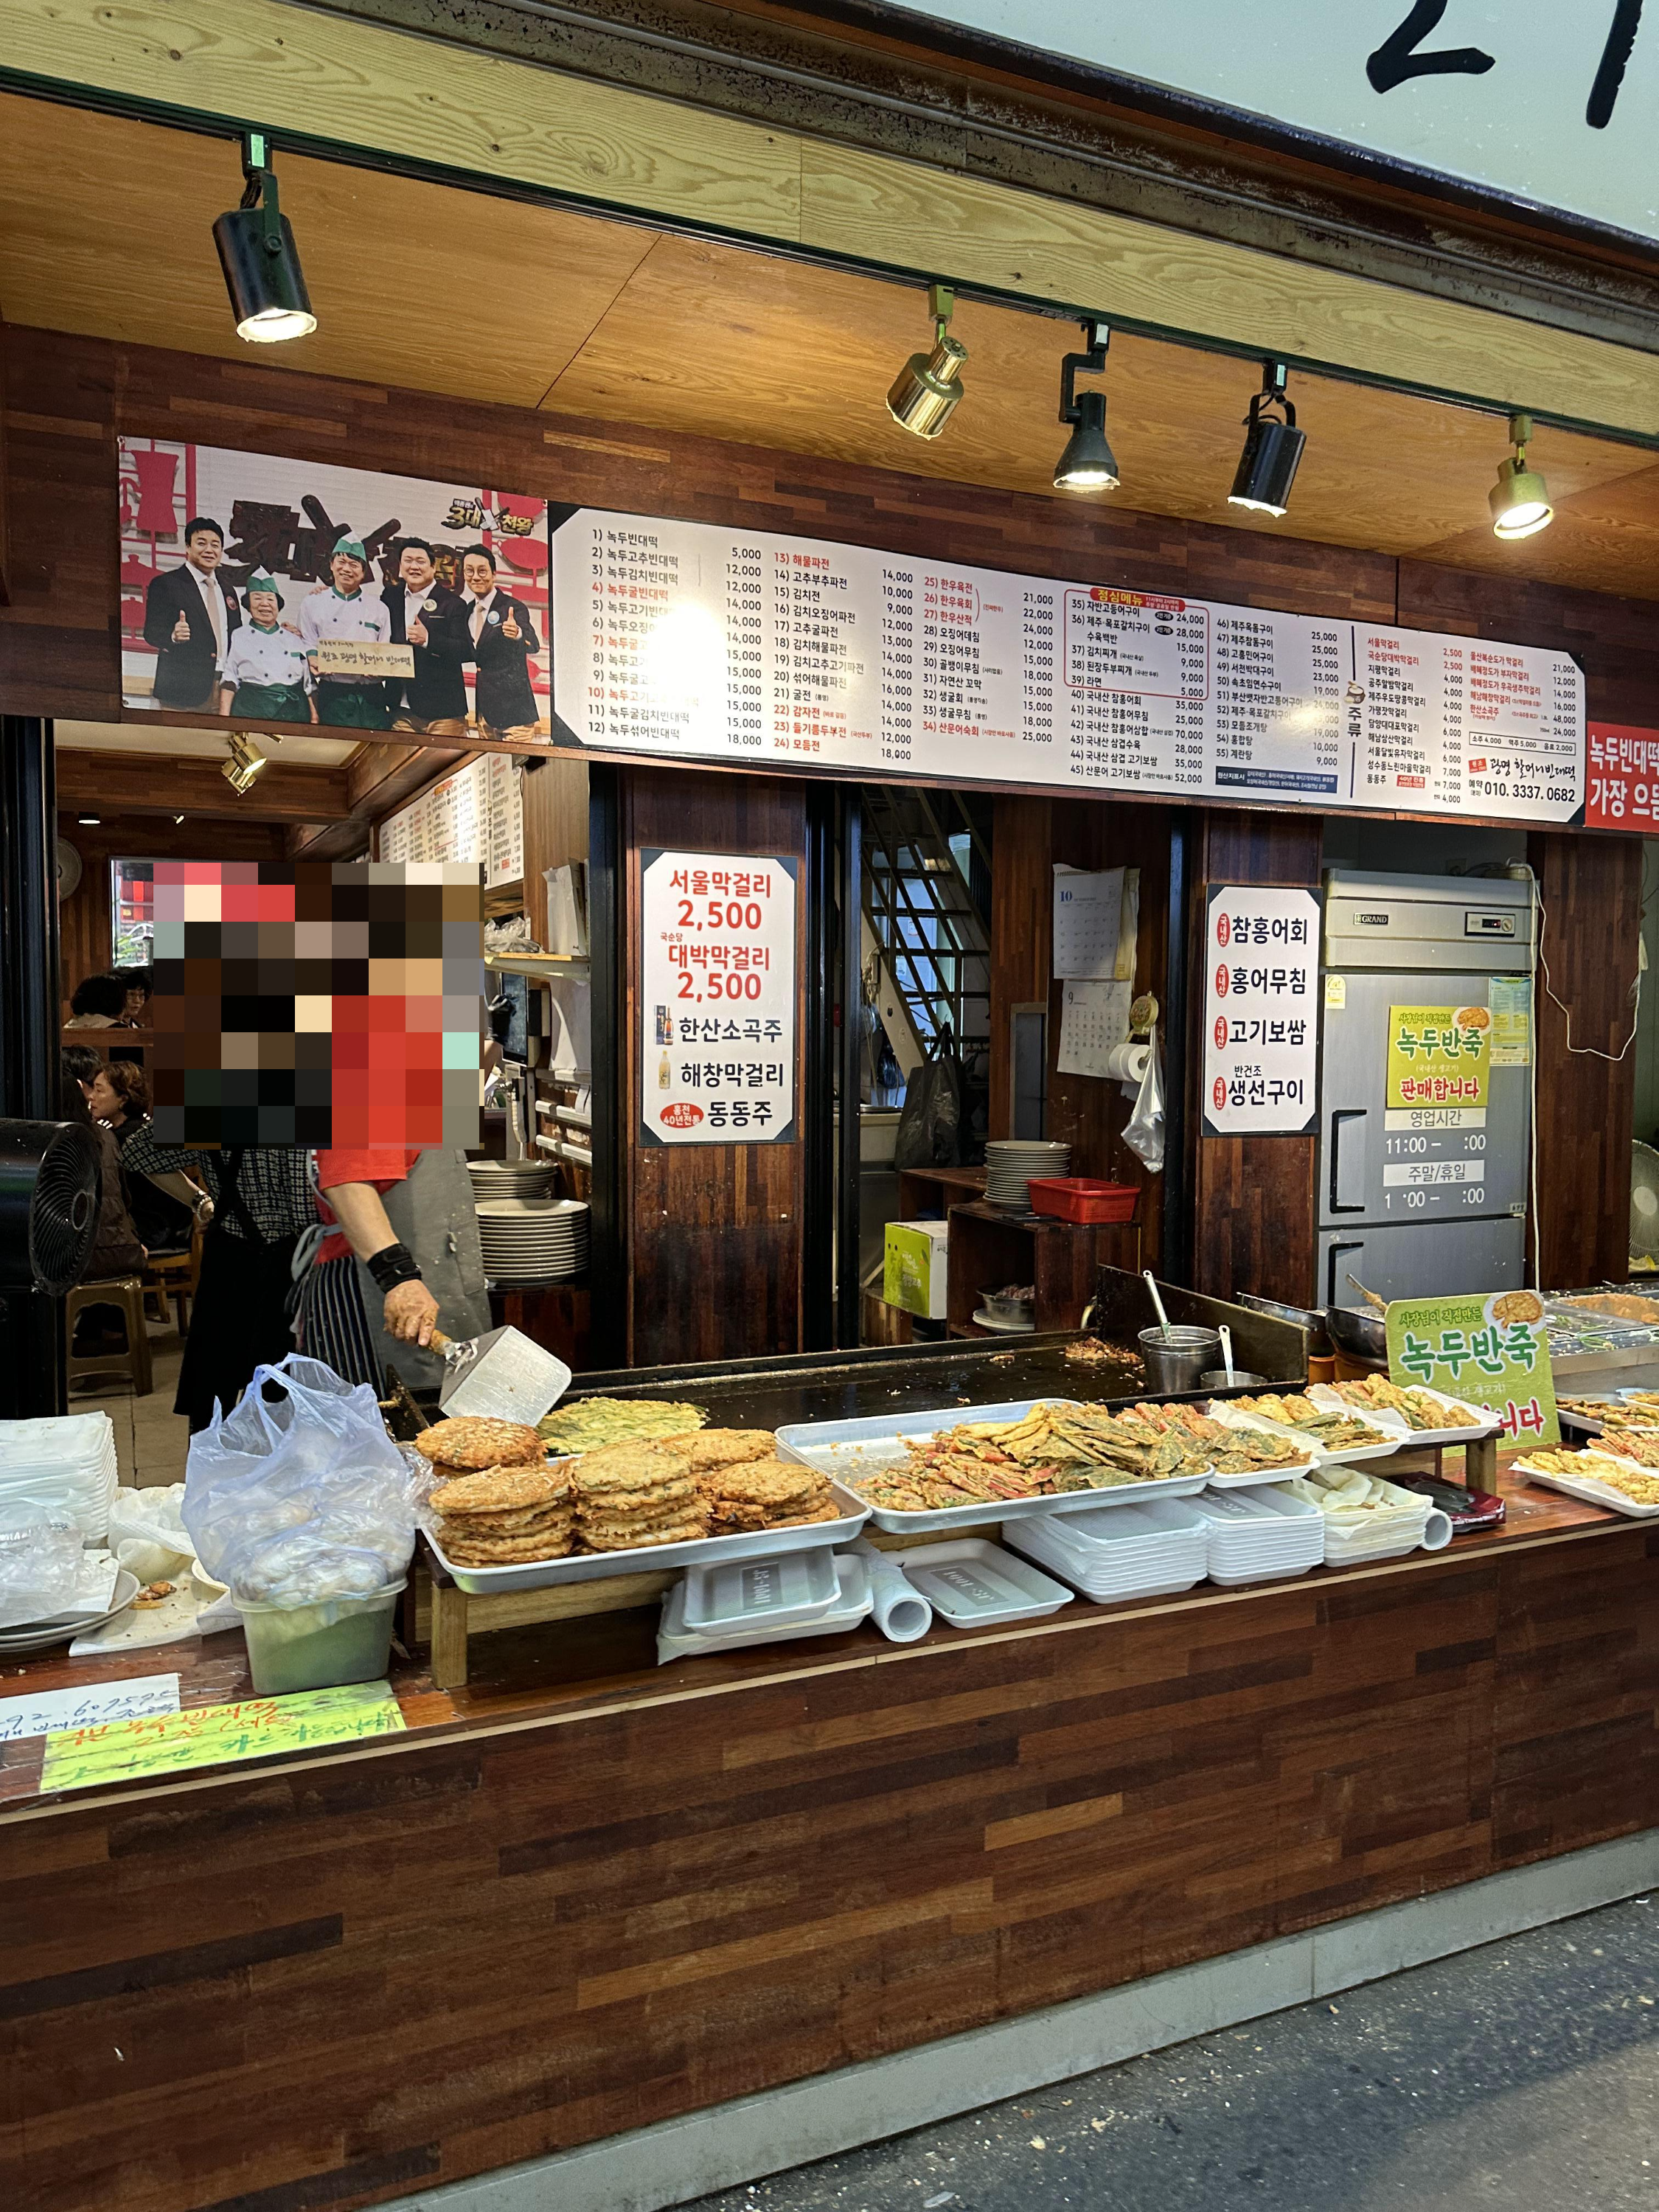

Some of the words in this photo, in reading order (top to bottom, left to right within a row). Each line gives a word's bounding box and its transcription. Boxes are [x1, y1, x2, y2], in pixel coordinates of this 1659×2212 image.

[593, 529, 602, 541] 1)
[607, 530, 657, 549] 녹두빈대떡
[731, 547, 761, 560] 5,000
[592, 546, 602, 559] 2)
[607, 548, 678, 568] 녹두고추빈대떡
[726, 563, 761, 577] 12,000
[774, 552, 789, 565] 13)
[793, 554, 829, 570] 해물파전
[883, 568, 913, 582] 14,000
[591, 581, 602, 594] 4)
[607, 582, 668, 601] 녹두굴빈대떡
[726, 597, 761, 611] 14,000
[774, 569, 789, 582] 14)
[793, 571, 846, 589] 고추부추파전
[882, 585, 912, 599] 10,000
[924, 576, 938, 588] 25)
[941, 578, 972, 594] 한우육전
[1023, 592, 1053, 605] 21,000
[774, 586, 789, 599] 15)
[793, 588, 819, 602] 김치전
[887, 602, 912, 615] 9,000
[1098, 588, 1142, 607] 점심메뉴
[774, 603, 789, 616] 16)
[793, 605, 855, 624] 김치오징어파전
[882, 618, 912, 632] 12,000
[924, 625, 937, 637] 28)
[939, 627, 979, 642] 오징어데침
[1023, 639, 1053, 650] 12,000
[1087, 631, 1117, 644] 수육백반
[1177, 642, 1203, 653] 15,000
[1367, 637, 1399, 650] 서울막걸리
[1443, 647, 1462, 658] 2,500
[774, 637, 789, 650] 18)
[793, 639, 846, 655] 김치해물파전
[882, 650, 912, 664] 14,000
[923, 641, 937, 653] 29)
[939, 643, 978, 658] 오징어무침
[1023, 654, 1052, 666] 15,000
[1368, 650, 1419, 666] 국순당대박막걸리
[1443, 661, 1462, 670] 2,500
[1217, 661, 1229, 672] 49)
[1231, 663, 1273, 677] 서천박대구이
[1313, 672, 1338, 682] 23,000
[1368, 664, 1400, 676] 지평막걸리
[1444, 674, 1462, 684] 4,000
[1506, 656, 1523, 667] 막걸리
[1553, 664, 1575, 673] 21,000
[923, 672, 936, 685] 31)
[939, 675, 963, 688] 자연산
[965, 678, 981, 690] 꼬막
[1023, 685, 1052, 697] 15,000
[1071, 675, 1086, 688] 39)
[1087, 676, 1101, 687] 라면
[1180, 686, 1203, 698] 5,000
[1217, 676, 1229, 686] 50)
[1231, 678, 1281, 692] 속초임연수구이
[1313, 686, 1338, 696] 19,000
[1071, 689, 1084, 700] 40)
[1086, 690, 1110, 703] 국내산
[1111, 692, 1141, 706] 참홍어회
[1175, 700, 1203, 711] 35,000
[588, 704, 604, 717] 11)
[609, 706, 689, 723] 녹두굴김치빈대떡
[727, 717, 761, 728] 15,000
[1348, 706, 1362, 737] 주류
[1368, 705, 1406, 718] 가평잣막걸리
[1443, 714, 1461, 724] 4,000
[588, 721, 605, 734] 12)
[609, 723, 678, 739] 녹두섞어빈대떡
[727, 734, 761, 745] 18,000
[1368, 718, 1419, 732] 담양대대포막걸리
[1443, 727, 1461, 737] 6,000
[773, 737, 789, 749] 24)
[881, 748, 911, 759] 18,000
[1071, 734, 1083, 745] 43)
[1085, 735, 1109, 748] 국내산
[1110, 738, 1141, 750] 삼겹수육
[1175, 744, 1202, 754] 28,000
[1368, 746, 1425, 760] 서울달빛유자막걸리
[1443, 754, 1461, 763] 6,000
[1509, 739, 1519, 747] 맥주
[1556, 744, 1573, 752] 2,000
[1489, 758, 1511, 776] 광명
[1469, 779, 1484, 788] 예약
[1547, 787, 1575, 802] 0682
[1590, 778, 1628, 817] 가장
[669, 869, 771, 898] 서울막걸리
[1060, 891, 1072, 902] 10
[678, 900, 762, 931] 2,500
[1362, 915, 1388, 924] GRAND
[660, 932, 683, 942] 국순당
[1232, 916, 1307, 945] 참홍어회
[669, 945, 769, 971] 대박막걸리
[678, 972, 761, 1003] 2,500
[1231, 967, 1306, 995] 홍어무침
[1068, 991, 1074, 1005] 9
[679, 1017, 782, 1043] 한산소곡주
[1399, 1012, 1425, 1023] 사장님이
[1425, 1013, 1451, 1024] 직접만든
[1229, 1020, 1307, 1046] 고기보쌈
[1396, 1027, 1484, 1059] 녹두반죽
[681, 1062, 783, 1088] 해창막걸리
[1234, 1065, 1262, 1078] 반건조
[1228, 1079, 1303, 1107] 생선구이
[1400, 1077, 1480, 1101] 판매합니다
[673, 1105, 690, 1115] 홍천
[708, 1101, 773, 1127] 동동주
[1411, 1109, 1462, 1128] 영업시간
[1386, 1136, 1427, 1154] 11:00
[1408, 1163, 1466, 1183] 주말/휴일
[1399, 1309, 1439, 1327] 사장님이
[1441, 1306, 1483, 1324] 직접만든
[1401, 1324, 1538, 1382] 녹두반죽
